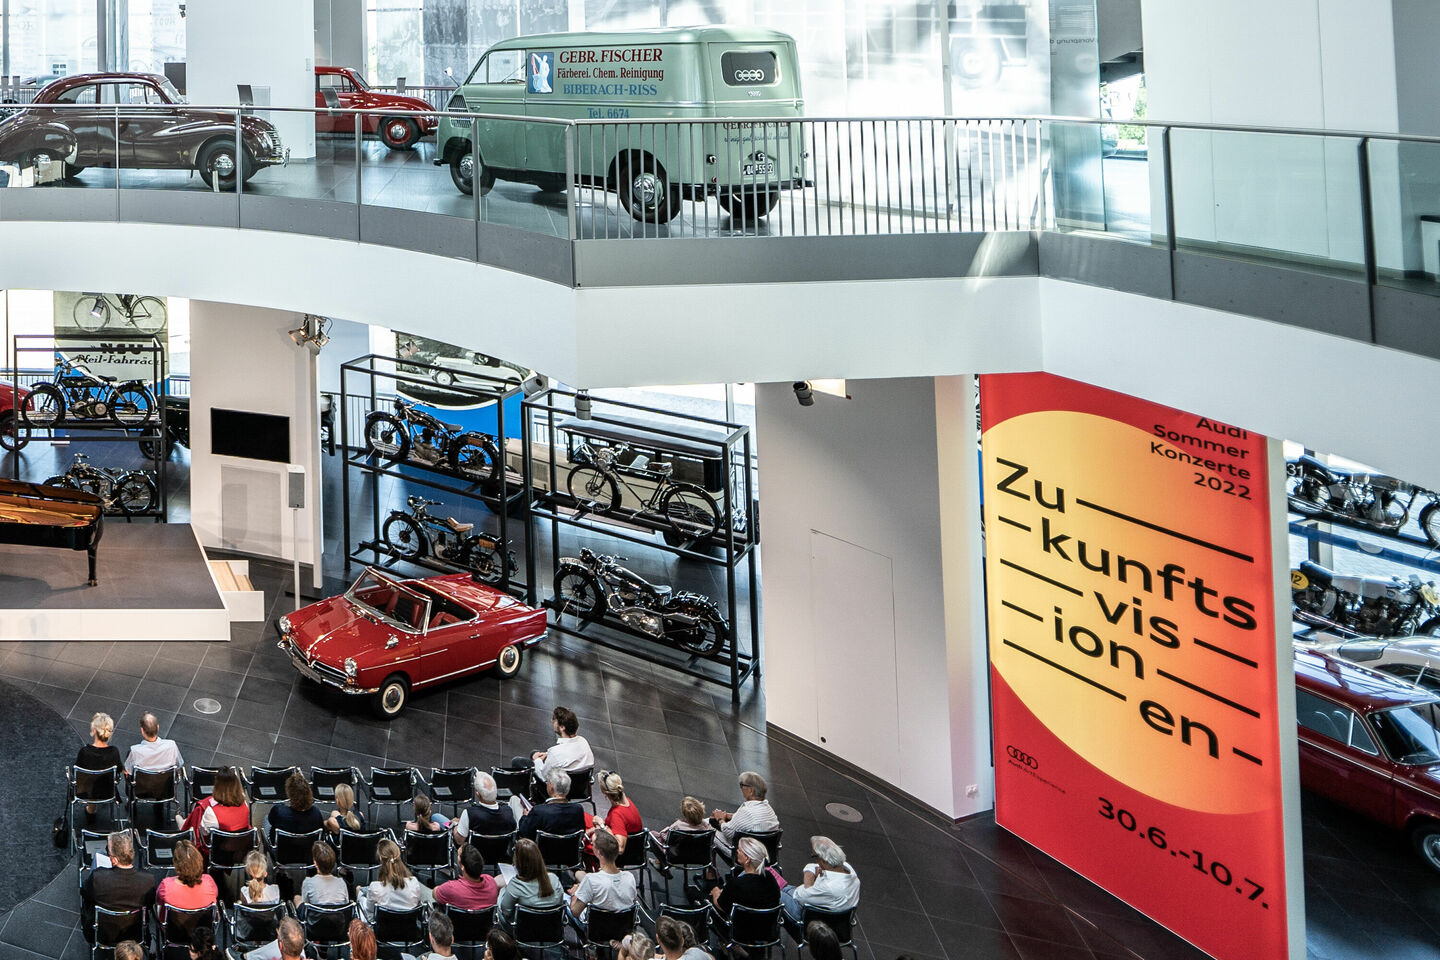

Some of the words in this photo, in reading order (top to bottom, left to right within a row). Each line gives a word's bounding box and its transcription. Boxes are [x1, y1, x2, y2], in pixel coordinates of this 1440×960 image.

[560, 50, 598, 63] GEBR.
[601, 48, 663, 62] FISCHER
[563, 84, 657, 96] BIBERACH-RISS
[593, 67, 618, 79] Chem.
[620, 67, 664, 81] Reinigung
[587, 108, 605, 119] Tel.
[1153, 424, 1250, 459] Sommer
[1196, 417, 1248, 440] Audi
[1151, 441, 1251, 480] Konzerte
[1287, 463, 1304, 477] 31
[996, 456, 1066, 514] Zu
[1194, 472, 1252, 500] 2022
[1041, 516, 1258, 631] kunfts
[1093, 590, 1181, 650] vis
[1054, 605, 1145, 680] ion
[1139, 699, 1220, 760] en
[1097, 796, 1269, 910] 30.6.-10.7.
